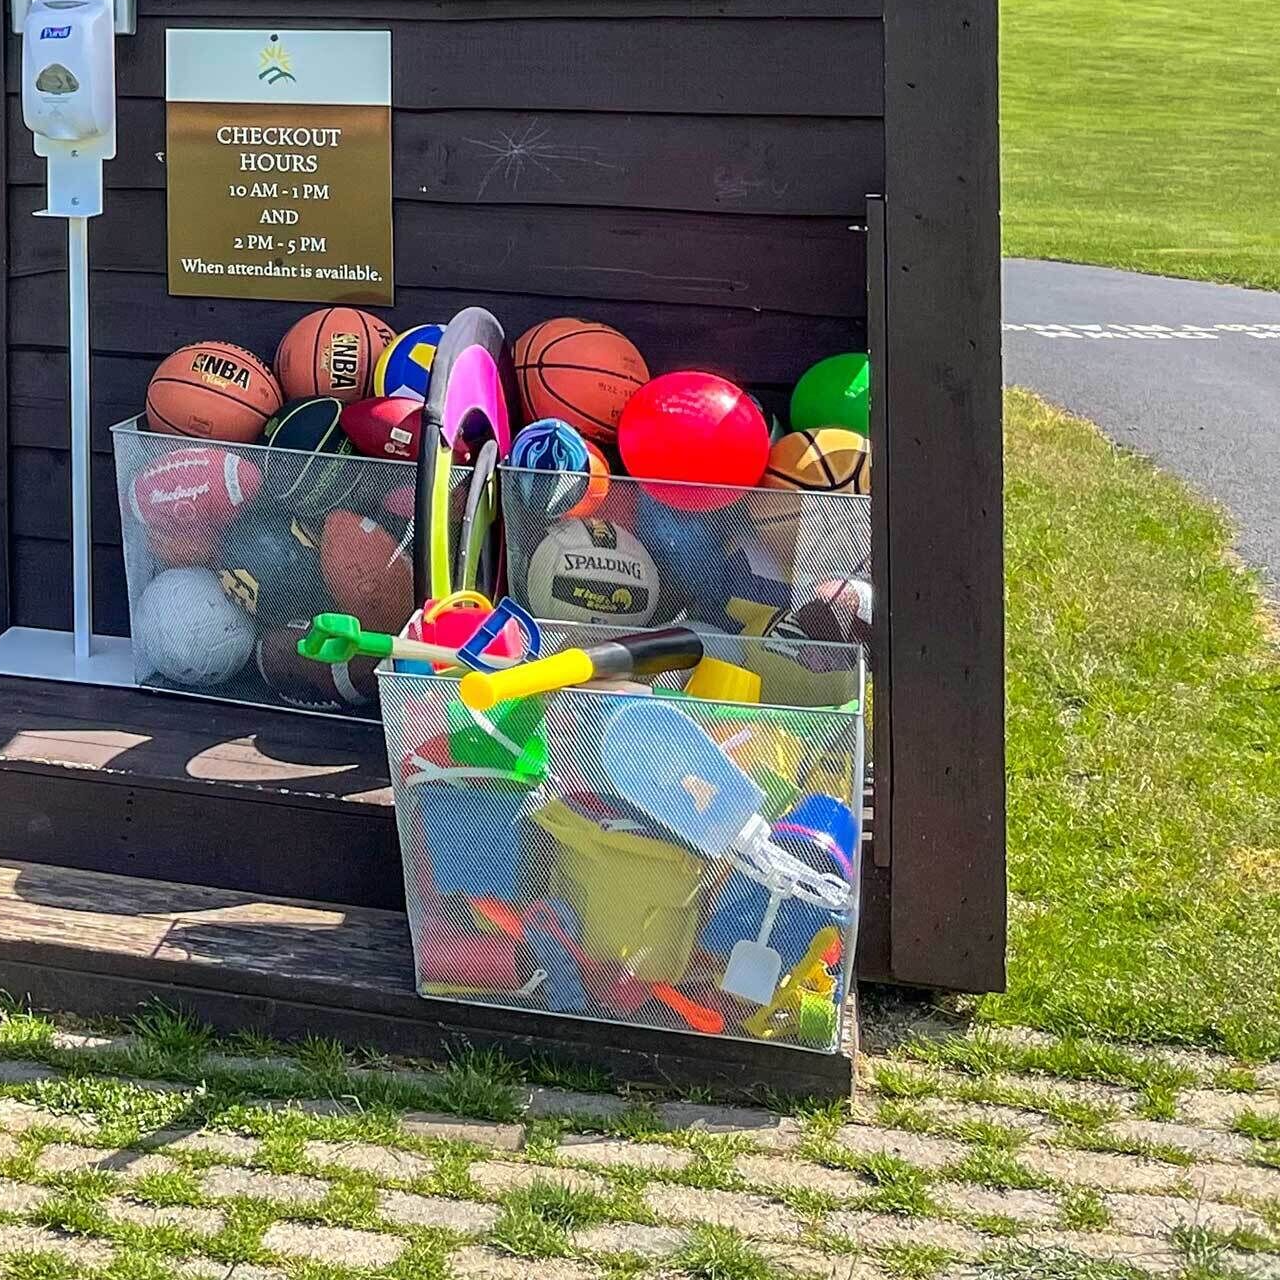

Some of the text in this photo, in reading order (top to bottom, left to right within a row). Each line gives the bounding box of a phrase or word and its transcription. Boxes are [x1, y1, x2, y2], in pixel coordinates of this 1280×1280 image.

[216, 126, 341, 147] CHECKOUT
[239, 153, 318, 173] HOURS
[229, 184, 247, 198] 10
[251, 183, 278, 198] AM
[292, 186, 299, 199] 1
[303, 184, 330, 200] PM
[259, 209, 299, 225] AND
[233, 237, 243, 250] 2
[247, 235, 273, 250] PM
[287, 239, 296, 254] 5
[300, 237, 327, 252] PM
[181, 258, 383, 282] When attendant is available.
[203, 355, 251, 390] NBA
[331, 344, 358, 389] NBA
[564, 553, 642, 580] SPALDING
